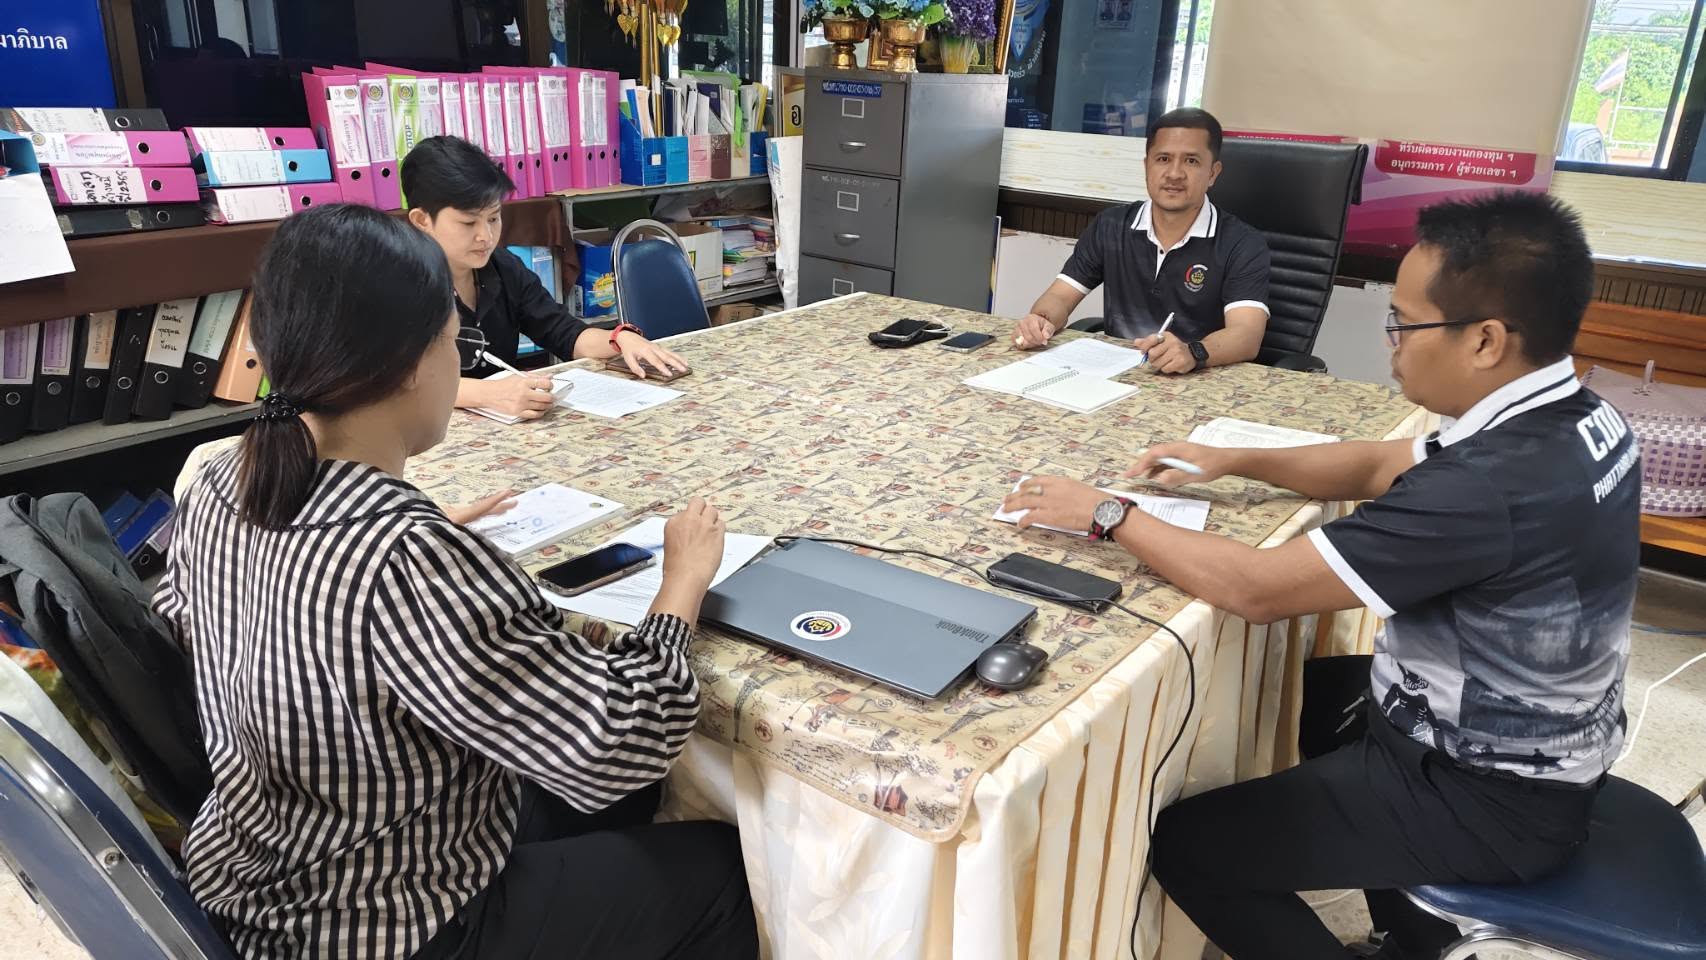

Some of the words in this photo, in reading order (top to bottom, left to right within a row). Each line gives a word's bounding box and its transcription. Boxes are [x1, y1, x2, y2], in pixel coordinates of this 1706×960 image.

[1391, 159, 1445, 172] อนุกรรมการ
[1447, 162, 1454, 172] /
[1456, 161, 1506, 177] ผู้ช่วยเลขา
[935, 619, 990, 644] ThinkBook
